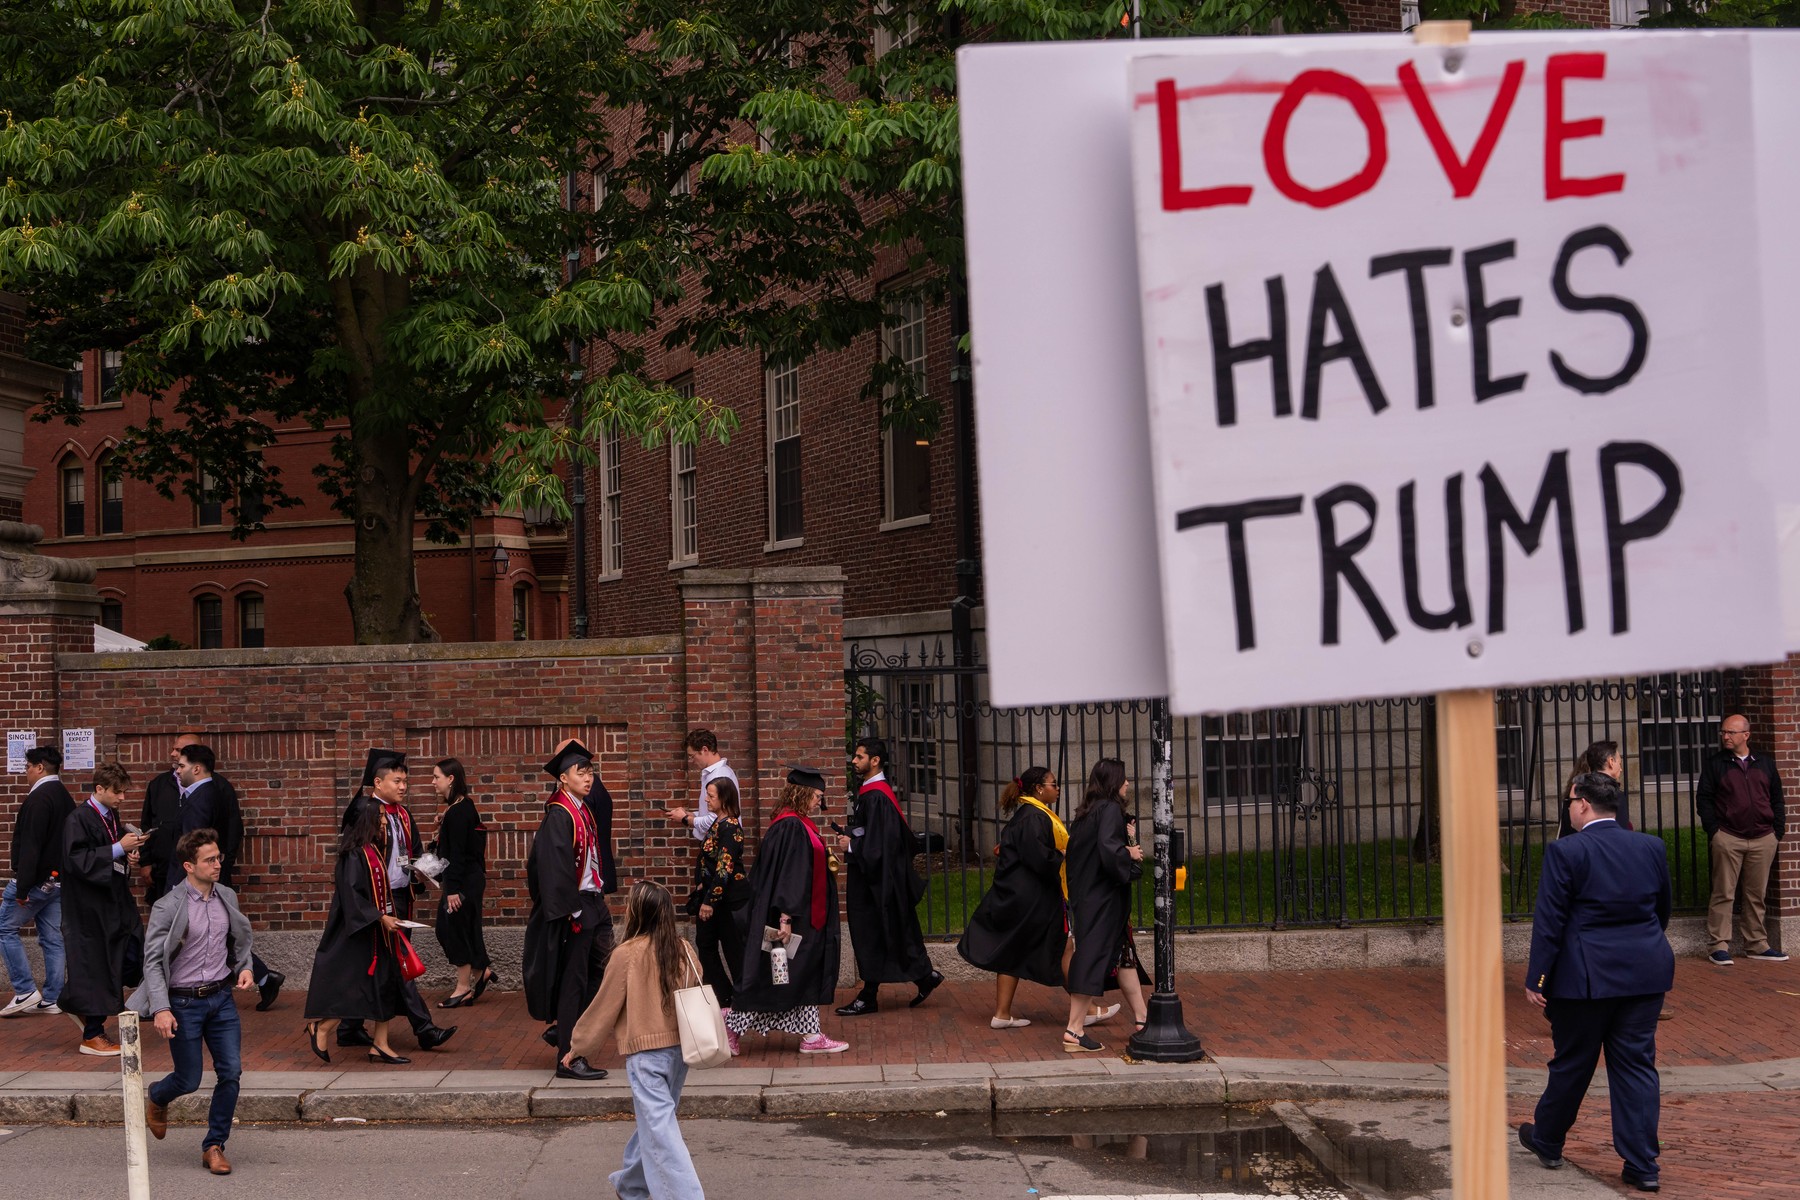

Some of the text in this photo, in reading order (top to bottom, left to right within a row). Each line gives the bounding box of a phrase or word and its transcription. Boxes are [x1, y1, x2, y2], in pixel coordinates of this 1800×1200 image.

[1157, 52, 1626, 211] LOVE
[1205, 224, 1650, 427] HATES
[1176, 441, 1684, 652] TRUMP
